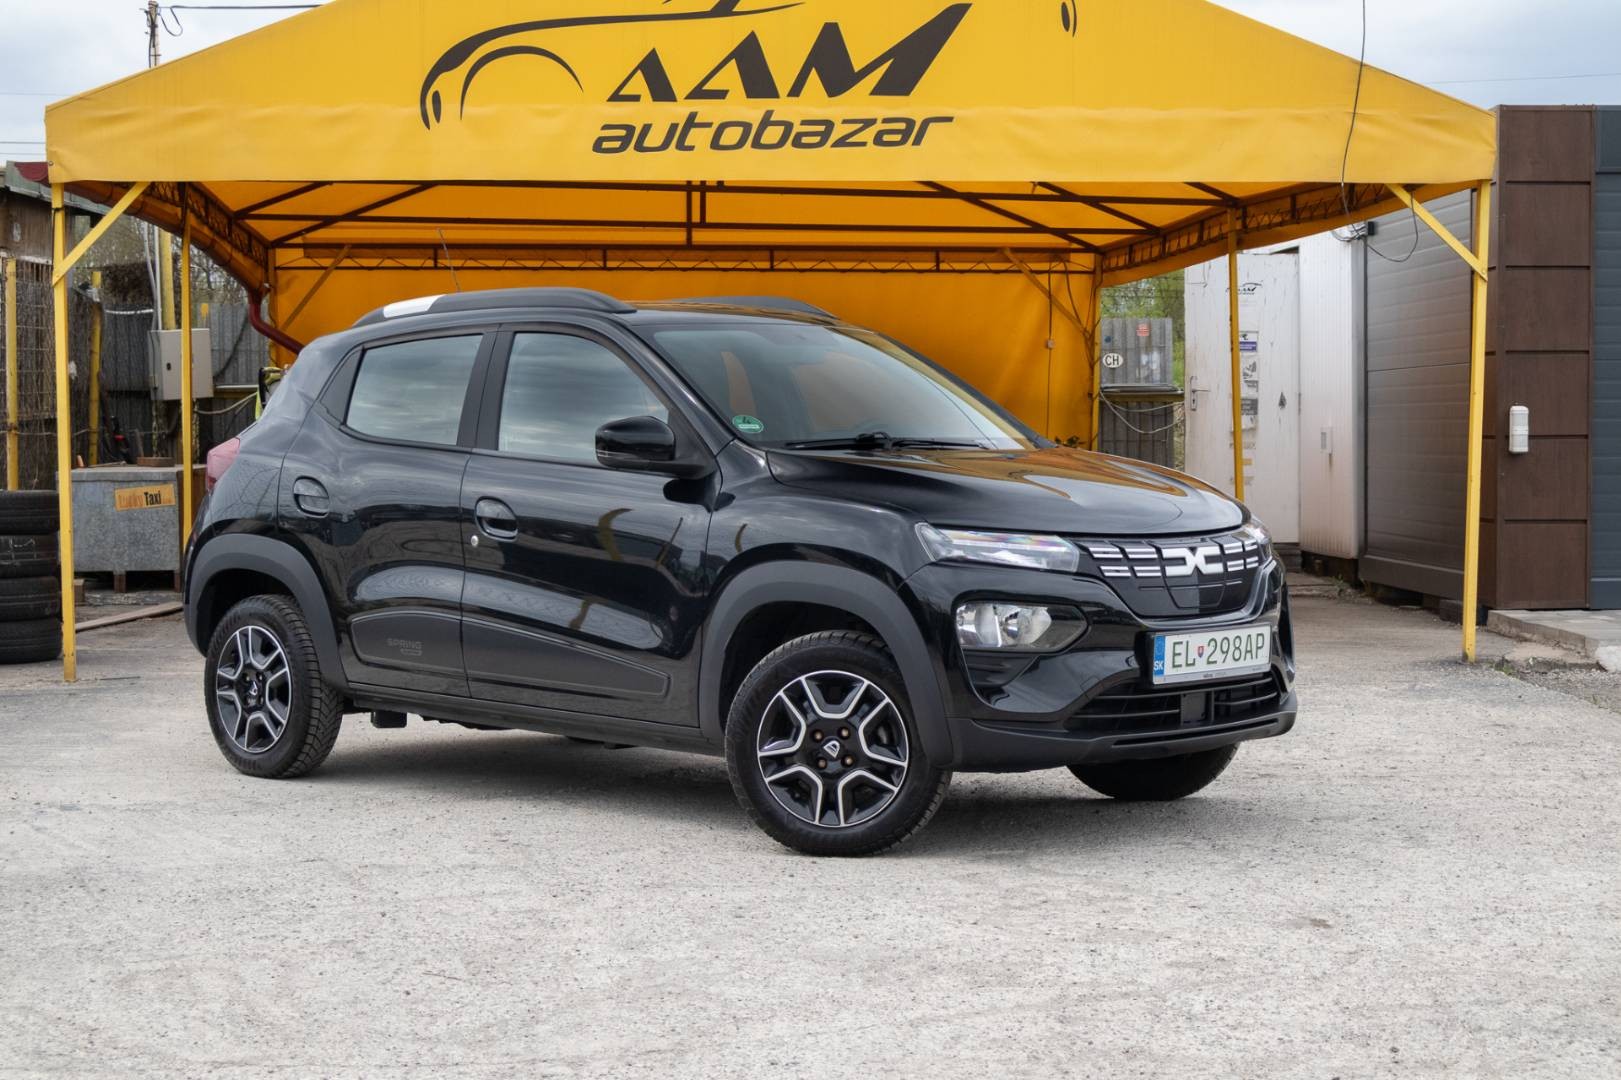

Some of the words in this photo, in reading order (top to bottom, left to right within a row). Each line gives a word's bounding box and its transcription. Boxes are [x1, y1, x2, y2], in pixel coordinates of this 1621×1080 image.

[605, 3, 972, 102] AAM
[592, 110, 955, 154] autobazar
[1105, 354, 1120, 366] CH
[144, 491, 162, 507] Taxi
[387, 638, 422, 649] SPRING
[1154, 660, 1164, 671] SK
